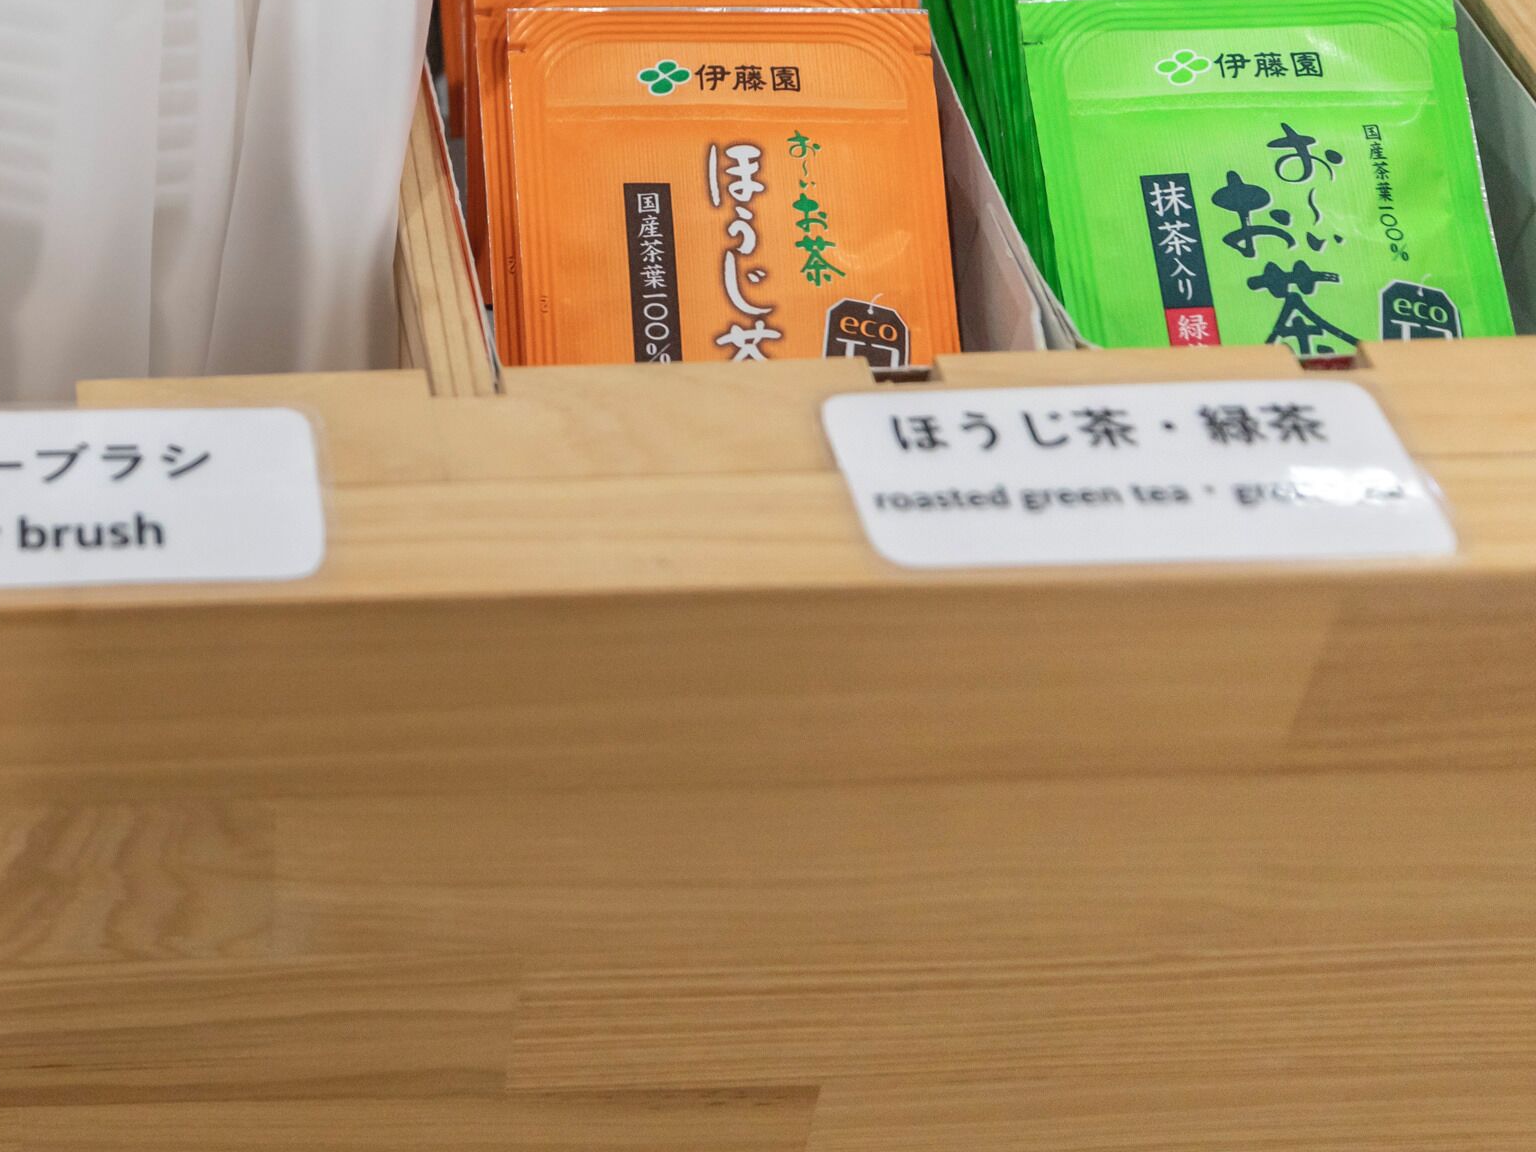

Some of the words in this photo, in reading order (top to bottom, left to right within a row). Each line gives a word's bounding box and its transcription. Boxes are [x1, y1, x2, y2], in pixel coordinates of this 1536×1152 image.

[695, 64, 802, 92] 伊藤園
[1214, 51, 1325, 79] 伊藤園
[1149, 180, 1198, 302] 抹茶入り
[1393, 296, 1449, 324] eco
[839, 315, 898, 342] eco
[874, 483, 1010, 512] roasted
[1022, 485, 1121, 512] green
[1131, 482, 1190, 504] tea
[17, 512, 165, 550] brush
